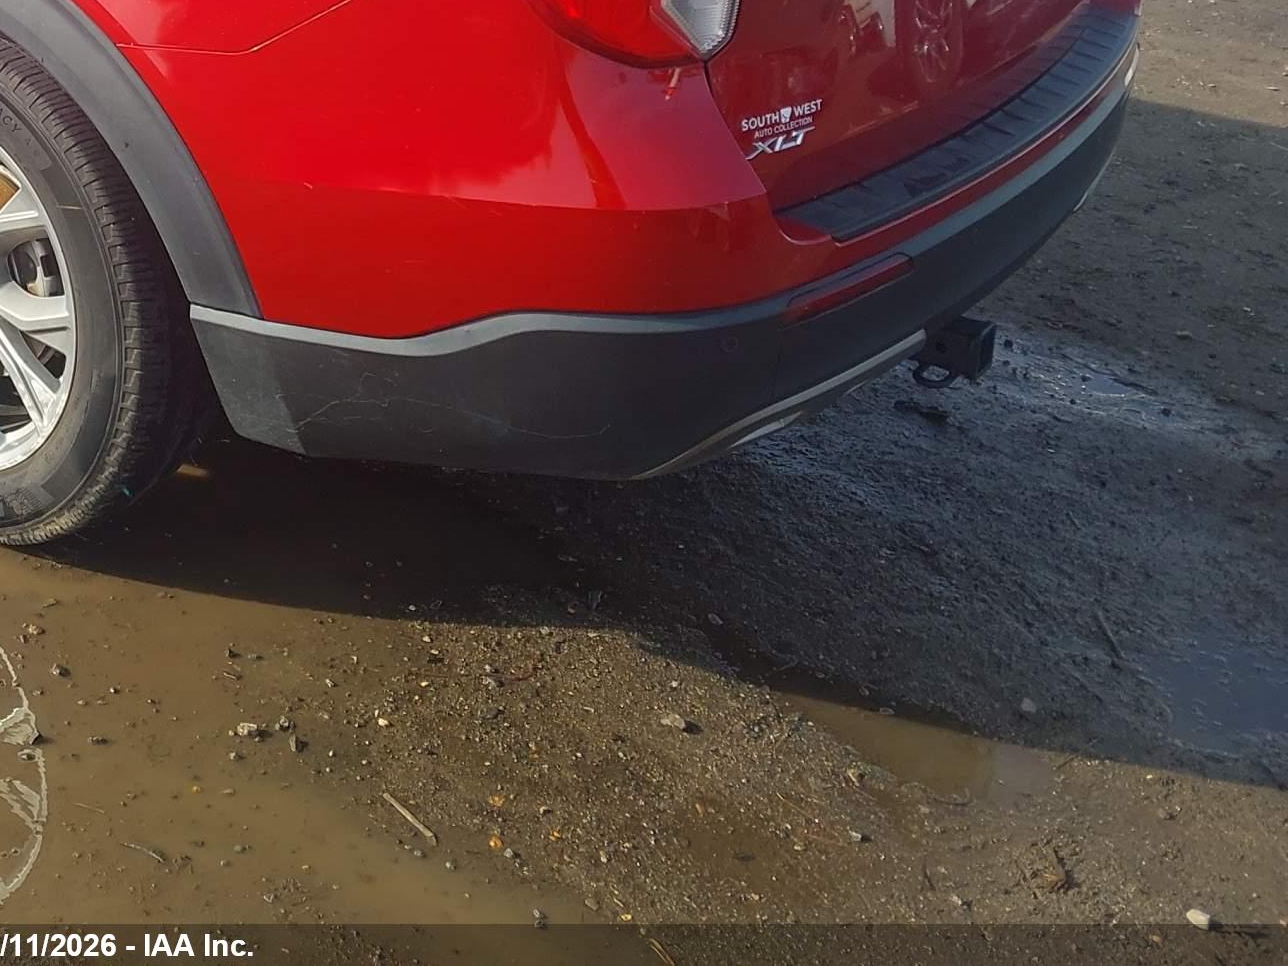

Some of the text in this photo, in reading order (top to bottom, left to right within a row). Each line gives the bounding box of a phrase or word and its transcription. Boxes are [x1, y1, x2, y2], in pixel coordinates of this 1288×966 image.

[742, 99, 822, 131] SOUTH WEST
[754, 116, 812, 139] AUTO COLLECTION
[745, 126, 816, 160] XLT
